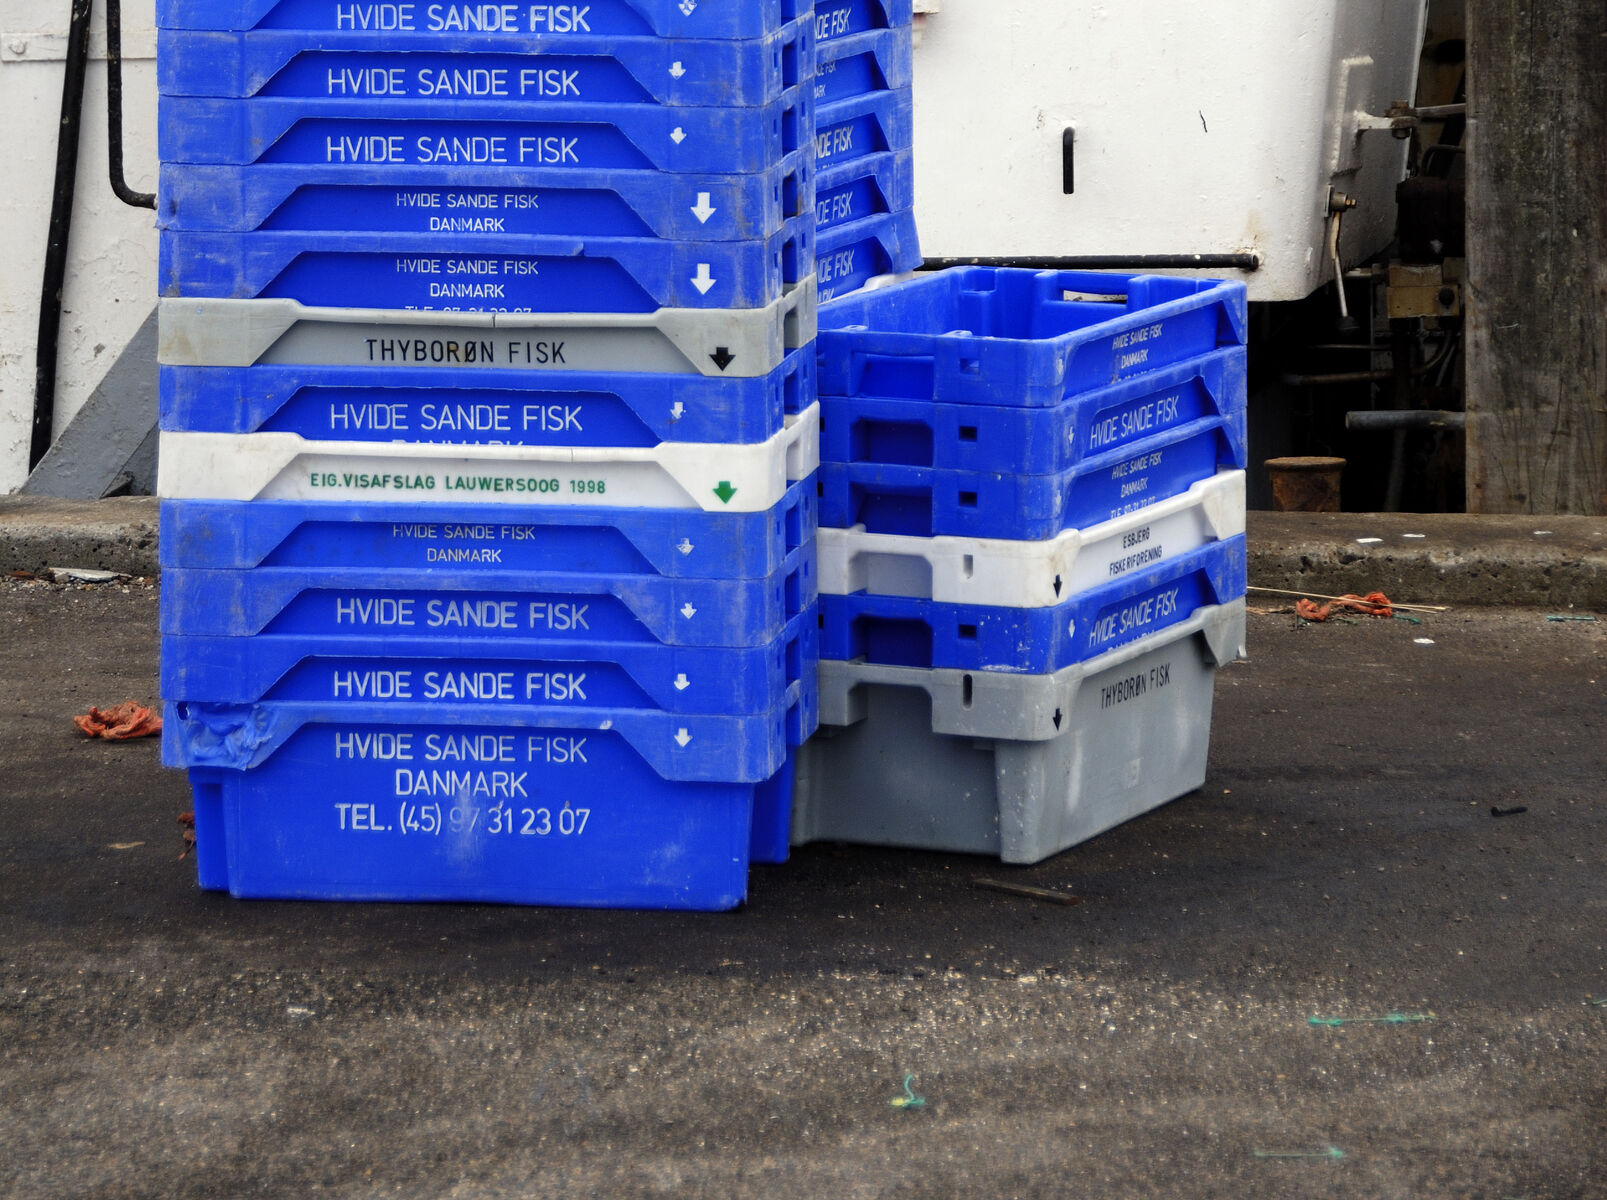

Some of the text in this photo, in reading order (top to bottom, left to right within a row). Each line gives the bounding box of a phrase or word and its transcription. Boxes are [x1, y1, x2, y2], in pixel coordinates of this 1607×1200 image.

[337, 5, 590, 33] HVIDE SANDE FISK
[831, 8, 851, 36] FISK
[328, 69, 580, 96] HVIDE SANDE FISK
[327, 137, 579, 163] HVIDE SANDE FISK
[833, 125, 854, 154] FISK
[397, 194, 539, 209] HVIDE SANDE FISK
[832, 191, 853, 220] FISK
[430, 217, 504, 232] DANMARK
[397, 260, 539, 275] HVIDE SANDE FISK
[834, 249, 855, 278] FISK
[430, 283, 505, 298] DANMARK
[1112, 323, 1163, 350] HVIDE SANDE FISK
[366, 339, 566, 364] THYBORØN FISK
[1121, 349, 1148, 369] DANMARK
[331, 404, 583, 431] HVIDE SANDE FISK
[1090, 395, 1180, 449] HVIDE SANDE FISK
[1112, 450, 1163, 480] HVIDE SANDE FISK
[446, 475, 560, 492] LAUWERSOOG
[570, 480, 606, 494] 1998
[1121, 477, 1148, 498] DANMARK
[393, 525, 536, 541] HVIDE SANDE FISK
[1123, 527, 1150, 549] ESBJERG
[427, 548, 501, 563] DANMARK
[337, 598, 589, 631] HVIDE SANDE FISK
[1089, 613, 1116, 648] HVIDE
[1119, 600, 1152, 635] SANDE
[1154, 587, 1179, 619] FISK
[334, 671, 587, 701] HVIDE SANDE FISK
[1101, 663, 1171, 710] THYBORØN FISK
[335, 733, 588, 763] HVIDE SANDE FISK
[395, 768, 528, 798] DANMARK
[335, 803, 392, 831] TEL.
[400, 801, 442, 835] (45)
[488, 806, 513, 834] 31
[520, 808, 551, 835] 23
[559, 808, 591, 835] 07
